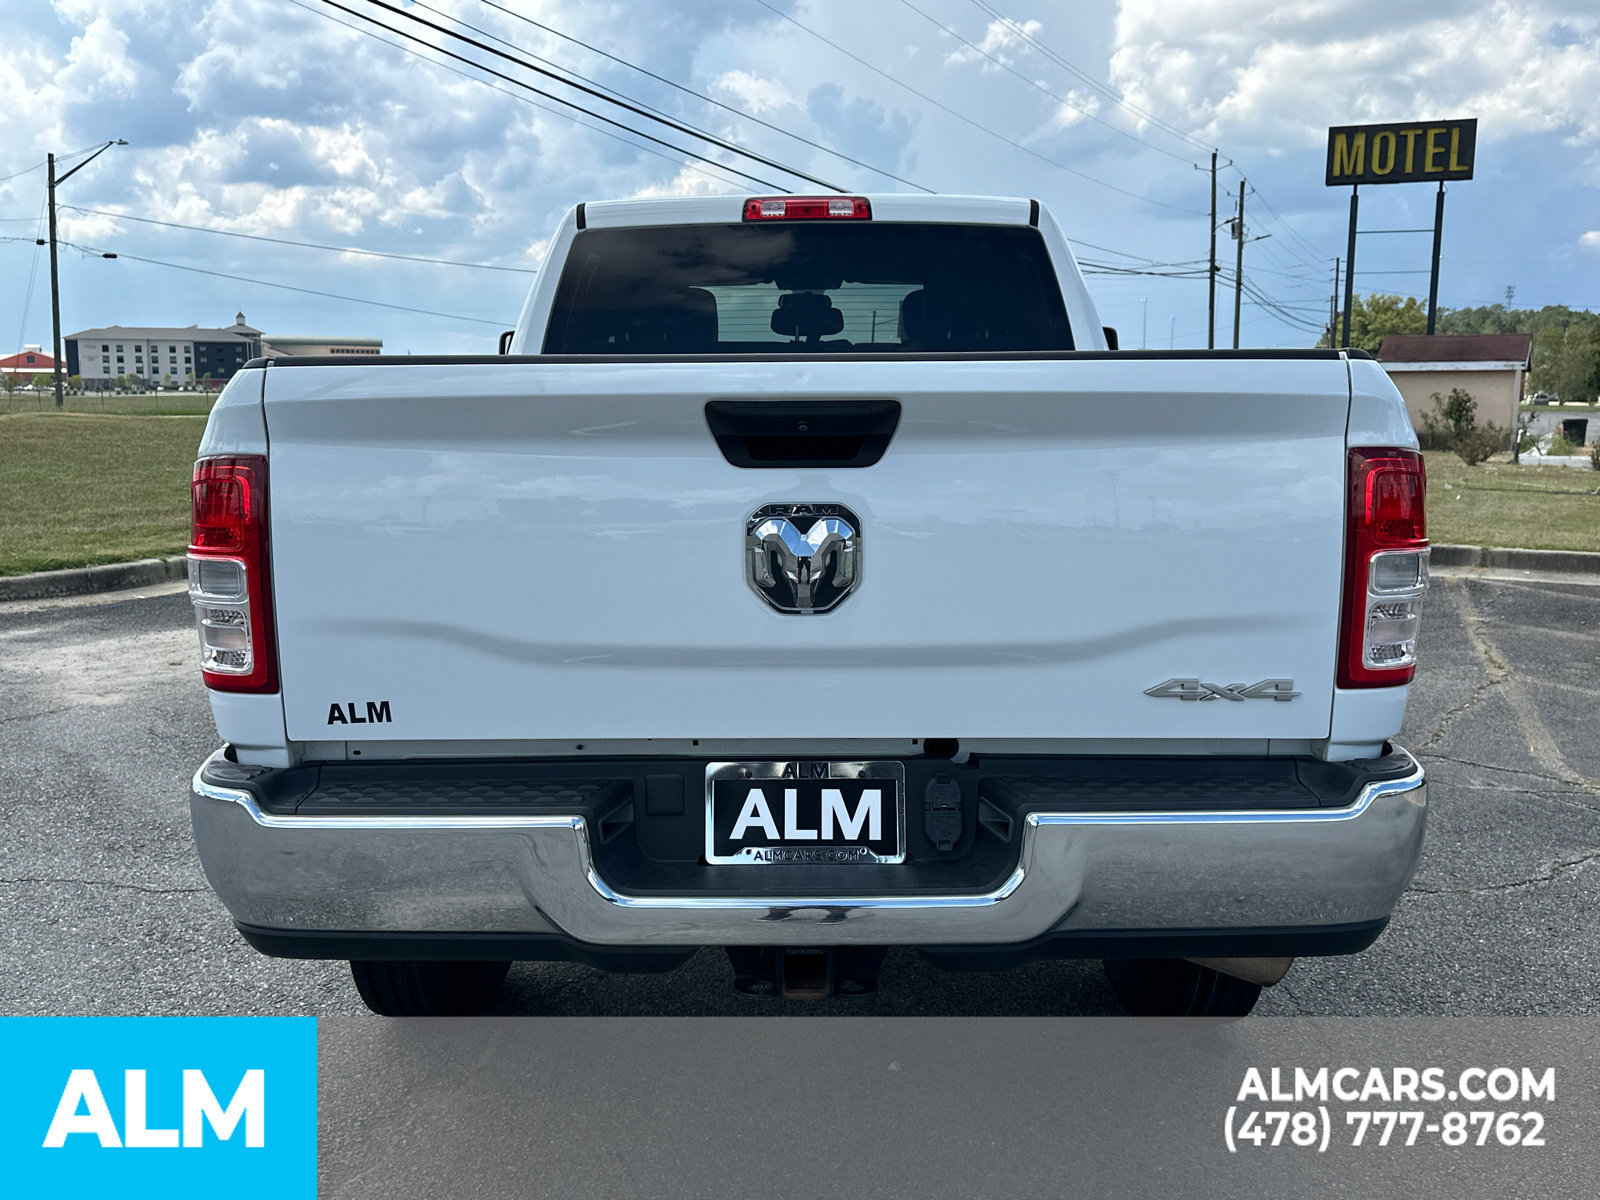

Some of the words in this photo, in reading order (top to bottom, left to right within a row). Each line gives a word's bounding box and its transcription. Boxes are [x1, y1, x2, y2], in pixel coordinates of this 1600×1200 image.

[1332, 127, 1470, 177] MOTEL
[769, 505, 838, 515] RAM
[1144, 678, 1303, 701] 4x4
[327, 701, 392, 725] ALM
[781, 762, 830, 779] ALM
[729, 788, 882, 841] ALM
[753, 848, 860, 862] ALMCARS.COM
